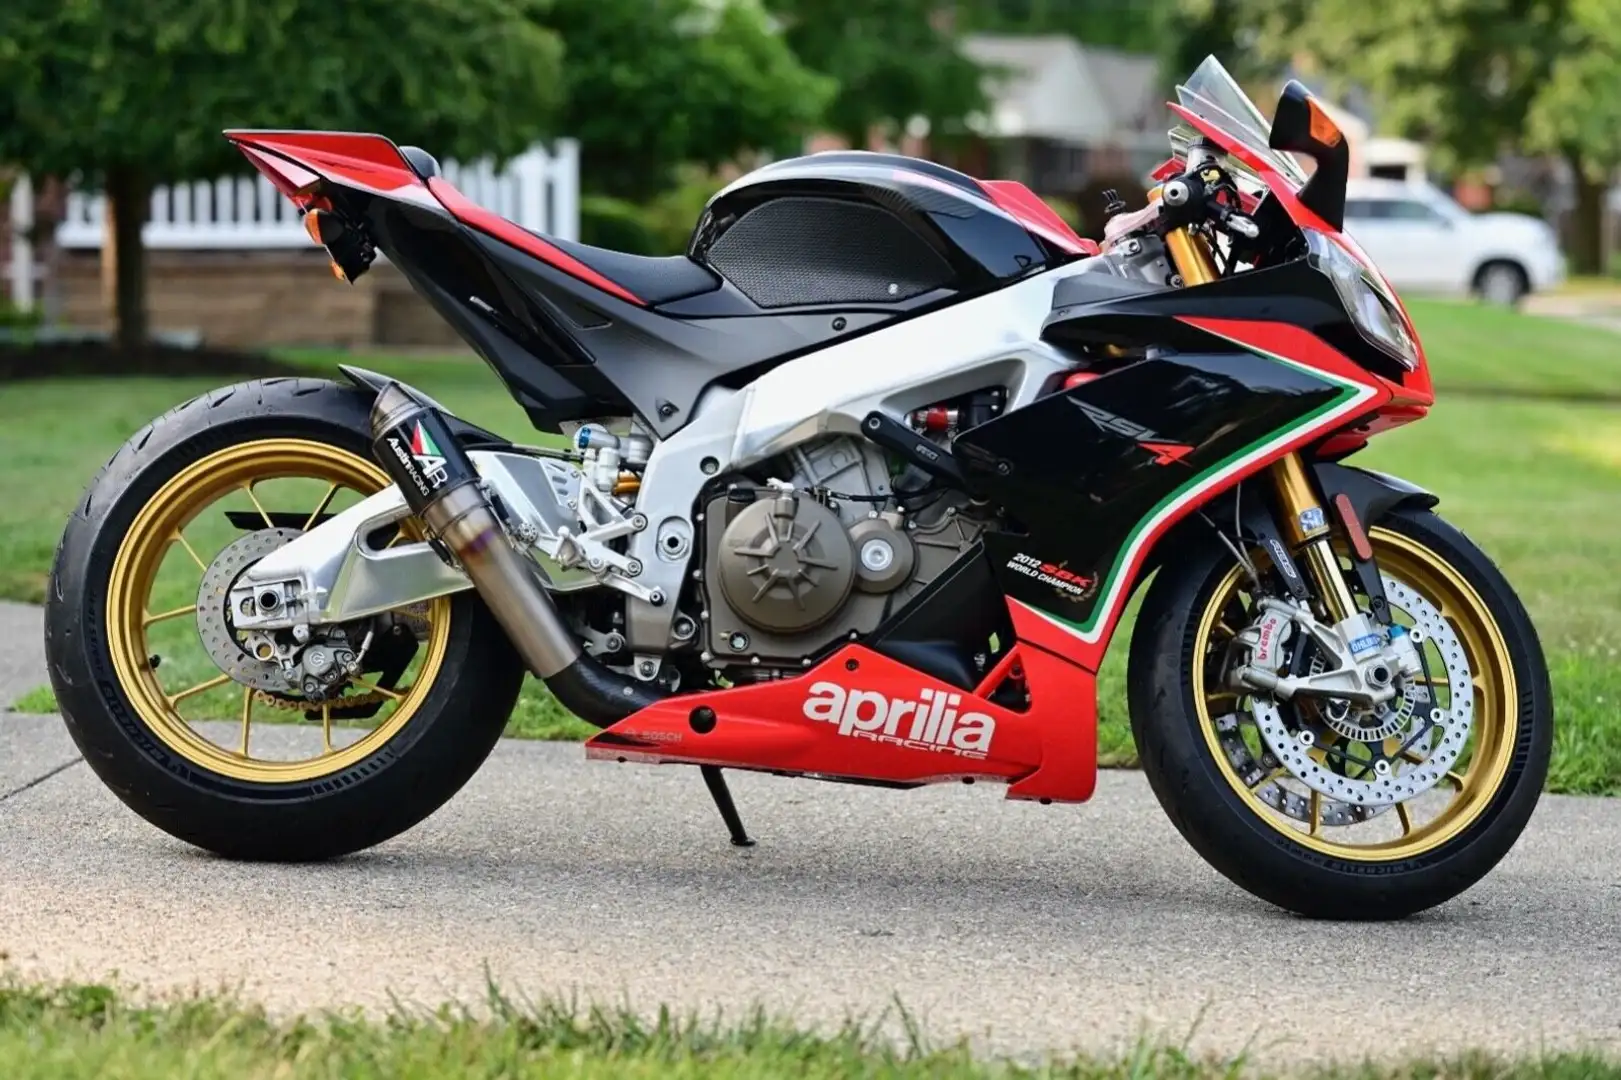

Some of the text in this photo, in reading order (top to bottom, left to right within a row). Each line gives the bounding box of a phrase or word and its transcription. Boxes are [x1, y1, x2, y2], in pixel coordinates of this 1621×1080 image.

[1006, 560, 1084, 595] WORLD CHAMPION
[1013, 553, 1093, 588] 2012 SBK
[1258, 618, 1277, 660] brembo
[802, 681, 996, 752] aprilia
[641, 731, 683, 742] BOSCH
[853, 730, 988, 760] RACING
